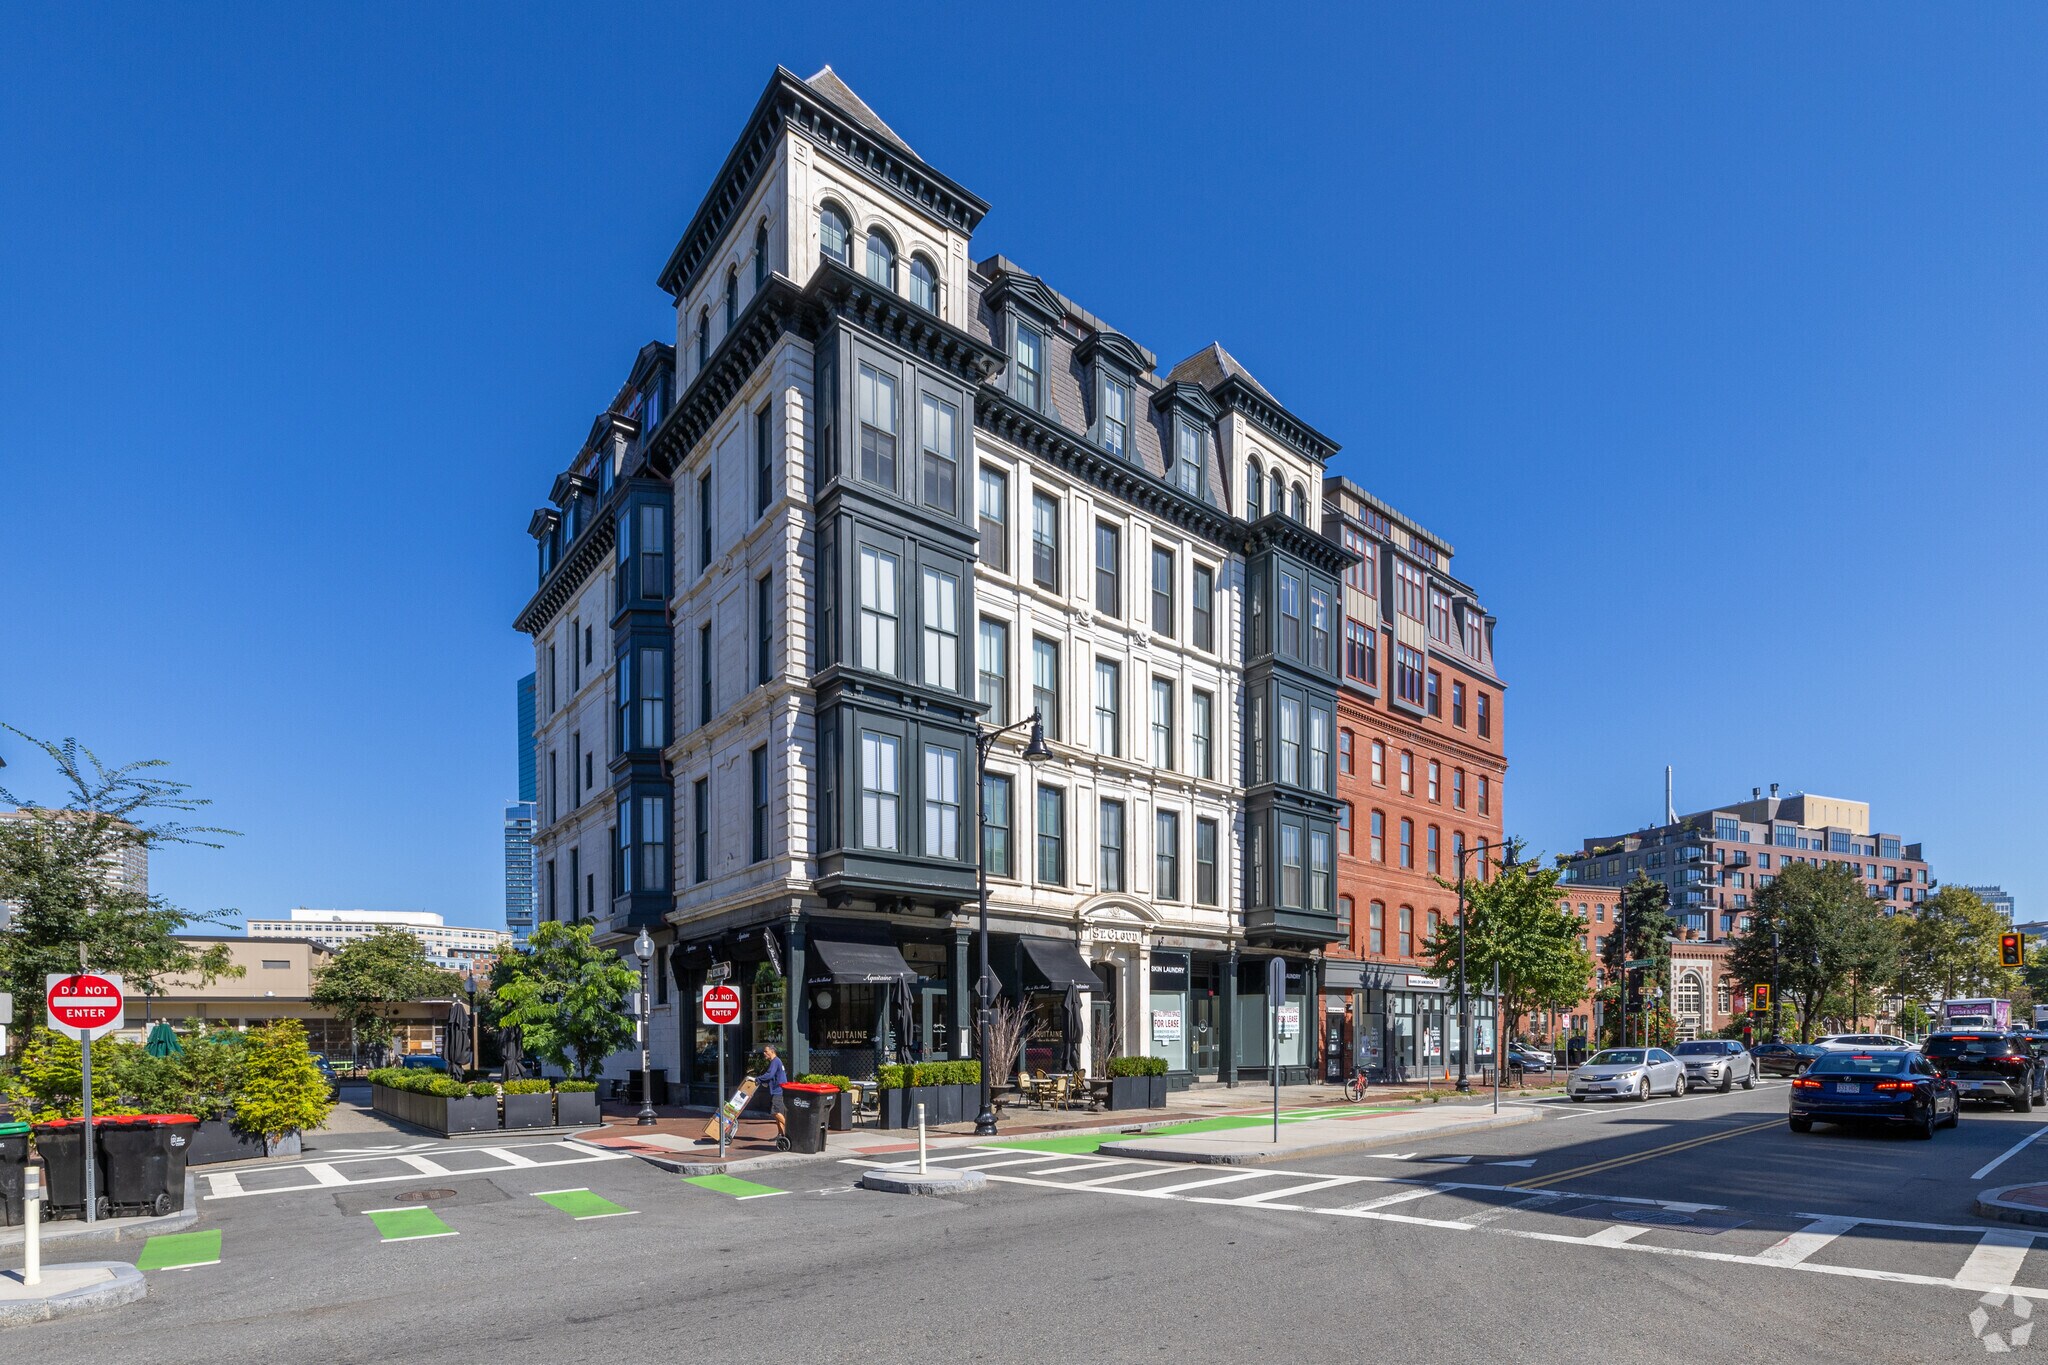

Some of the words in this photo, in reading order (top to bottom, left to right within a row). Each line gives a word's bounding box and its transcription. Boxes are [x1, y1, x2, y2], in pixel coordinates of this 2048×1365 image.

[863, 973, 892, 983] Aquitaine
[61, 986, 78, 995] DO
[85, 986, 108, 995] NOT
[66, 1009, 105, 1018] ENTER
[1165, 1020, 1179, 1028] LEASE
[826, 1030, 868, 1039] AQUITAINE
